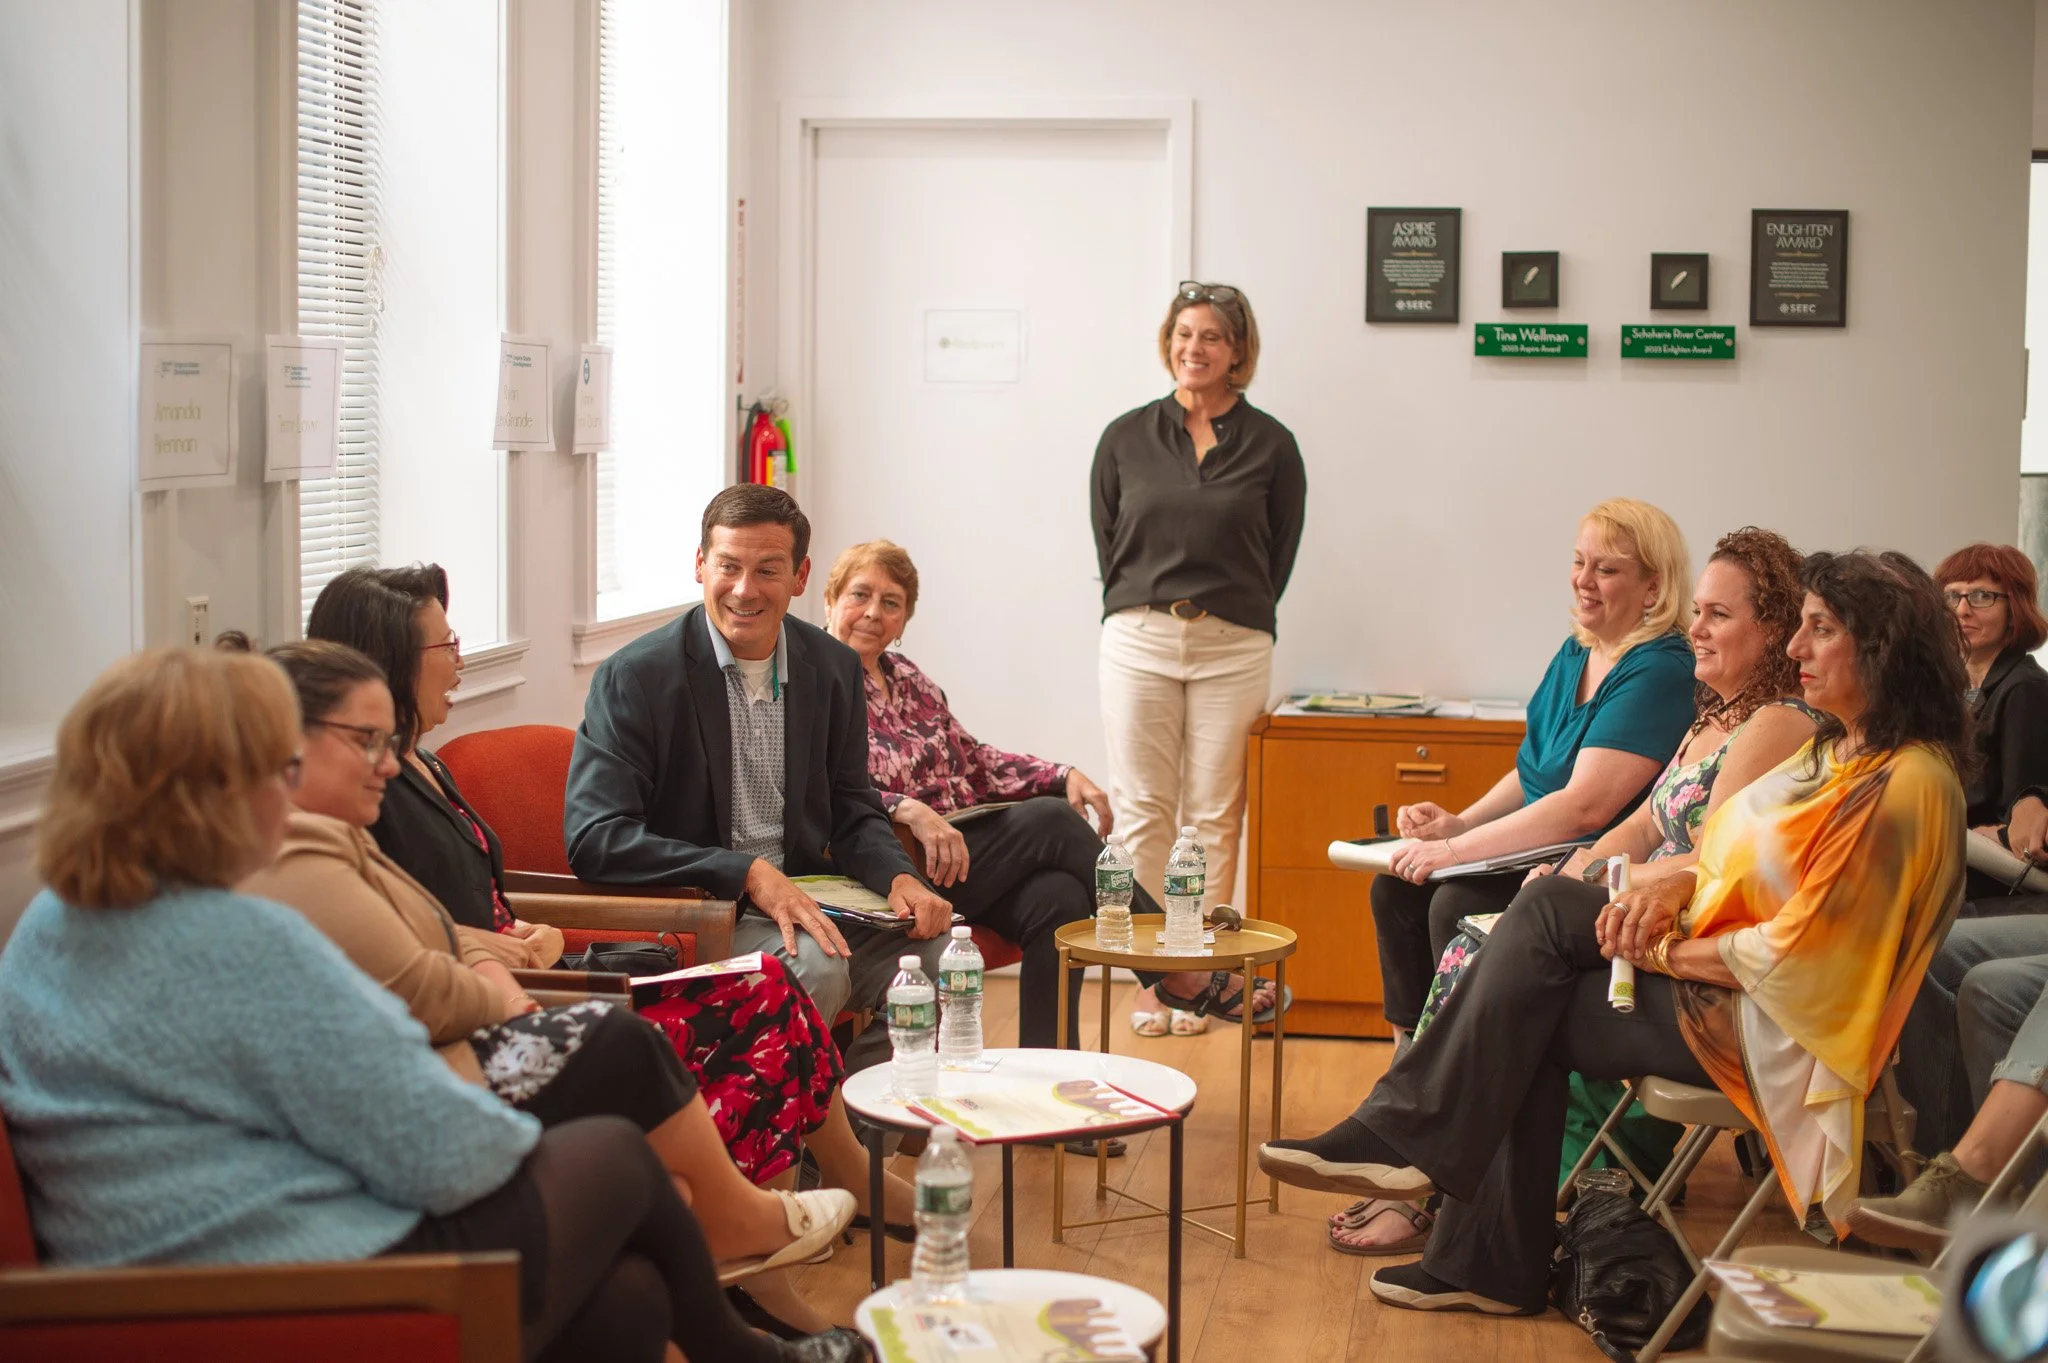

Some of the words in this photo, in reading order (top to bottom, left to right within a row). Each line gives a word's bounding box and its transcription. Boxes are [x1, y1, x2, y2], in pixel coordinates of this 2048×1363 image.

[1392, 221, 1437, 237] ASPIRE
[1766, 223, 1834, 237] ENLIGHTEN
[1392, 236, 1437, 248] AWARD
[1775, 236, 1824, 249] AWARD
[1405, 300, 1433, 311] SEEC
[1789, 303, 1817, 314] SEEC
[1493, 326, 1517, 342] Tina
[1519, 327, 1569, 343] Wellman
[1631, 327, 1672, 340] Schoharie
[1673, 328, 1694, 340] River
[1696, 328, 1725, 340] Center
[1692, 345, 1713, 354] Award
[154, 400, 201, 421] Amanda
